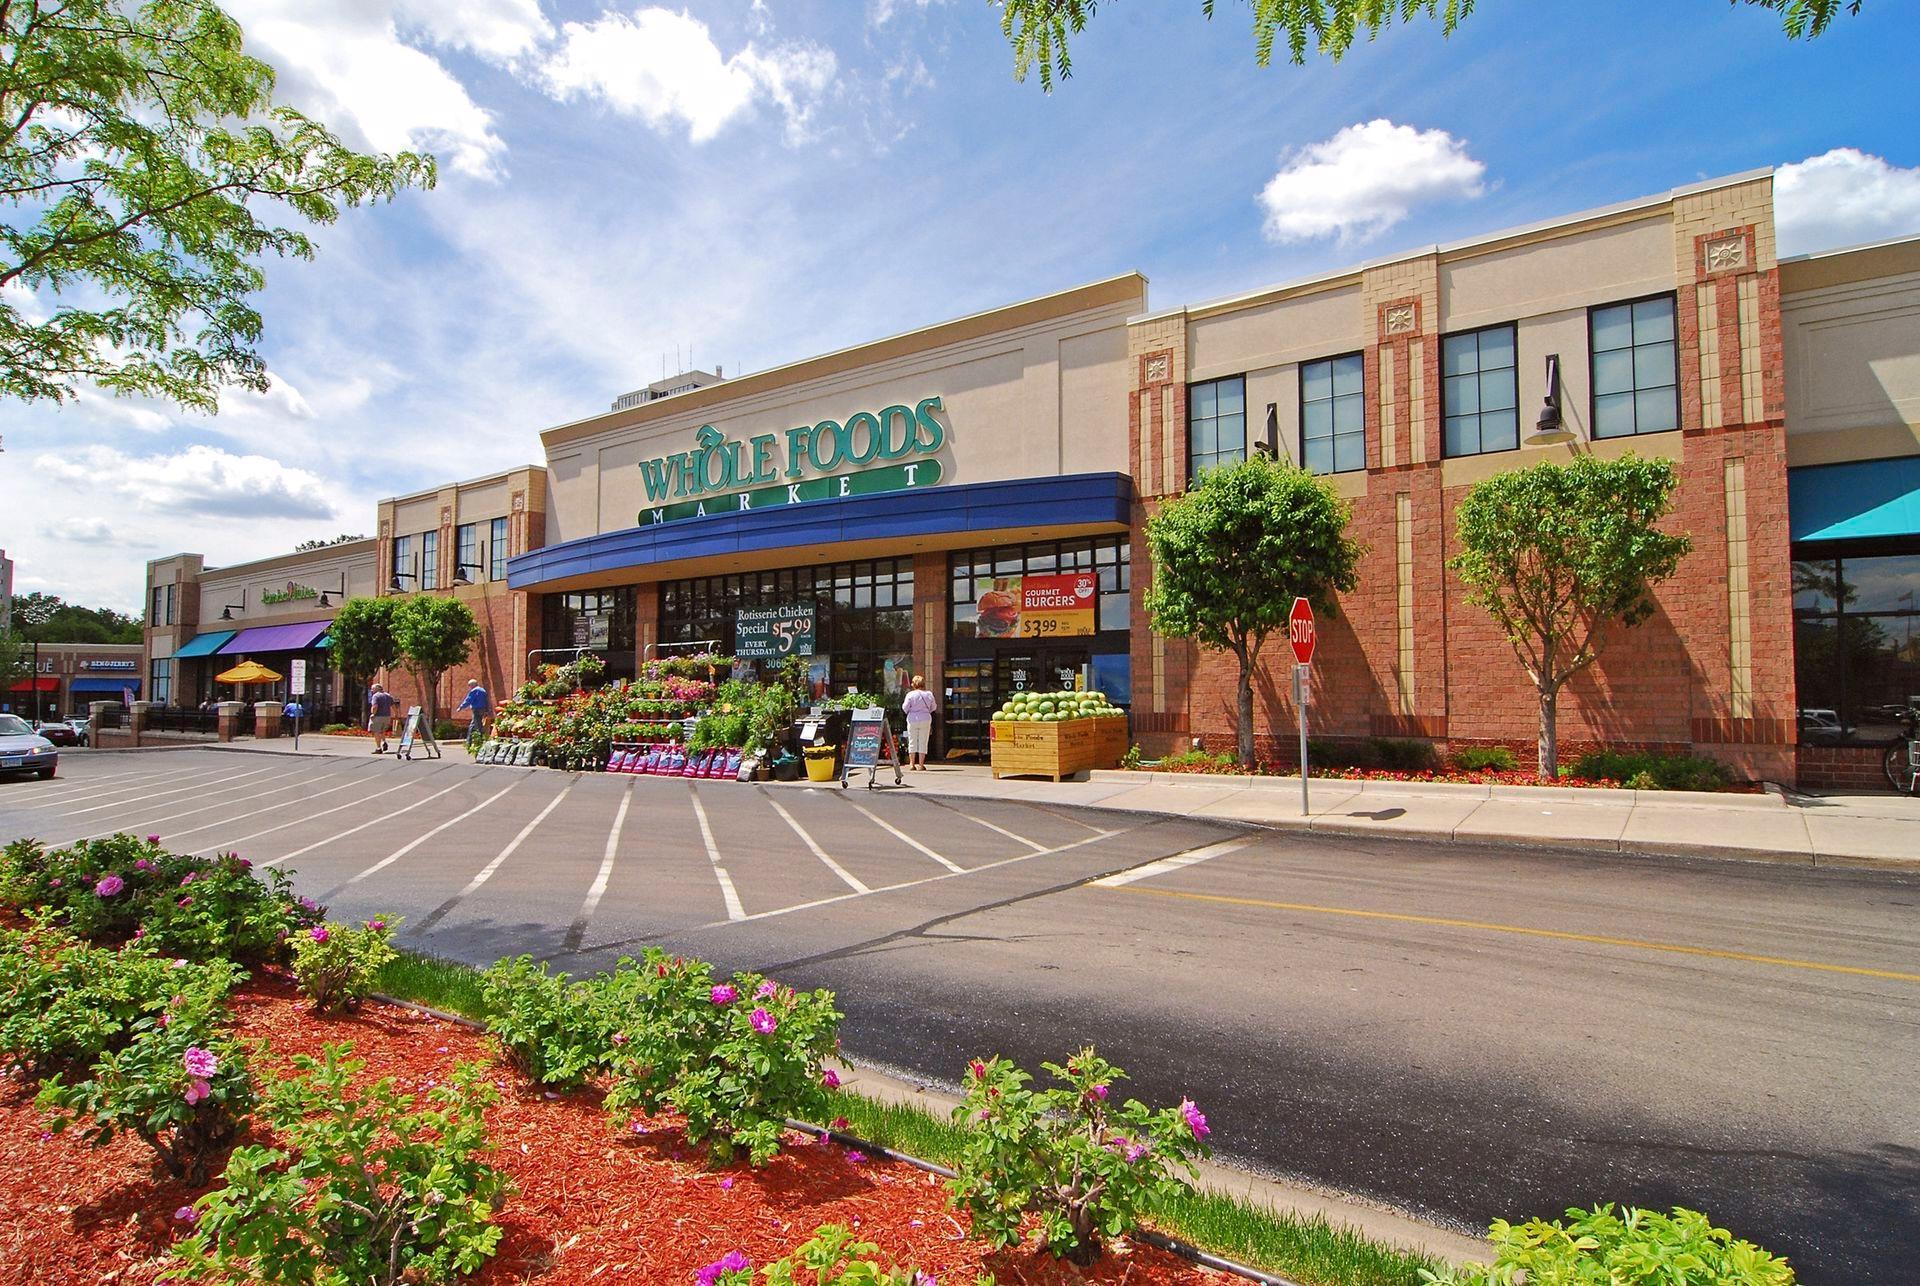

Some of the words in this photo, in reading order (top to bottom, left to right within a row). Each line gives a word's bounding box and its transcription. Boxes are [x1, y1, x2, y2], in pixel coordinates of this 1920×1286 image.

[638, 425, 777, 502] WHOLE
[785, 395, 946, 478] FOODS
[651, 463, 918, 525] MARKET
[1025, 588, 1060, 597] GOURMET
[1025, 595, 1076, 608] BURGERS
[737, 608, 778, 621] Rotisserie
[778, 605, 814, 618] Chicken
[736, 621, 769, 637] Special
[1292, 618, 1313, 644] STOP
[735, 648, 776, 656] THURSDAY!
[744, 640, 768, 648] EVERY
